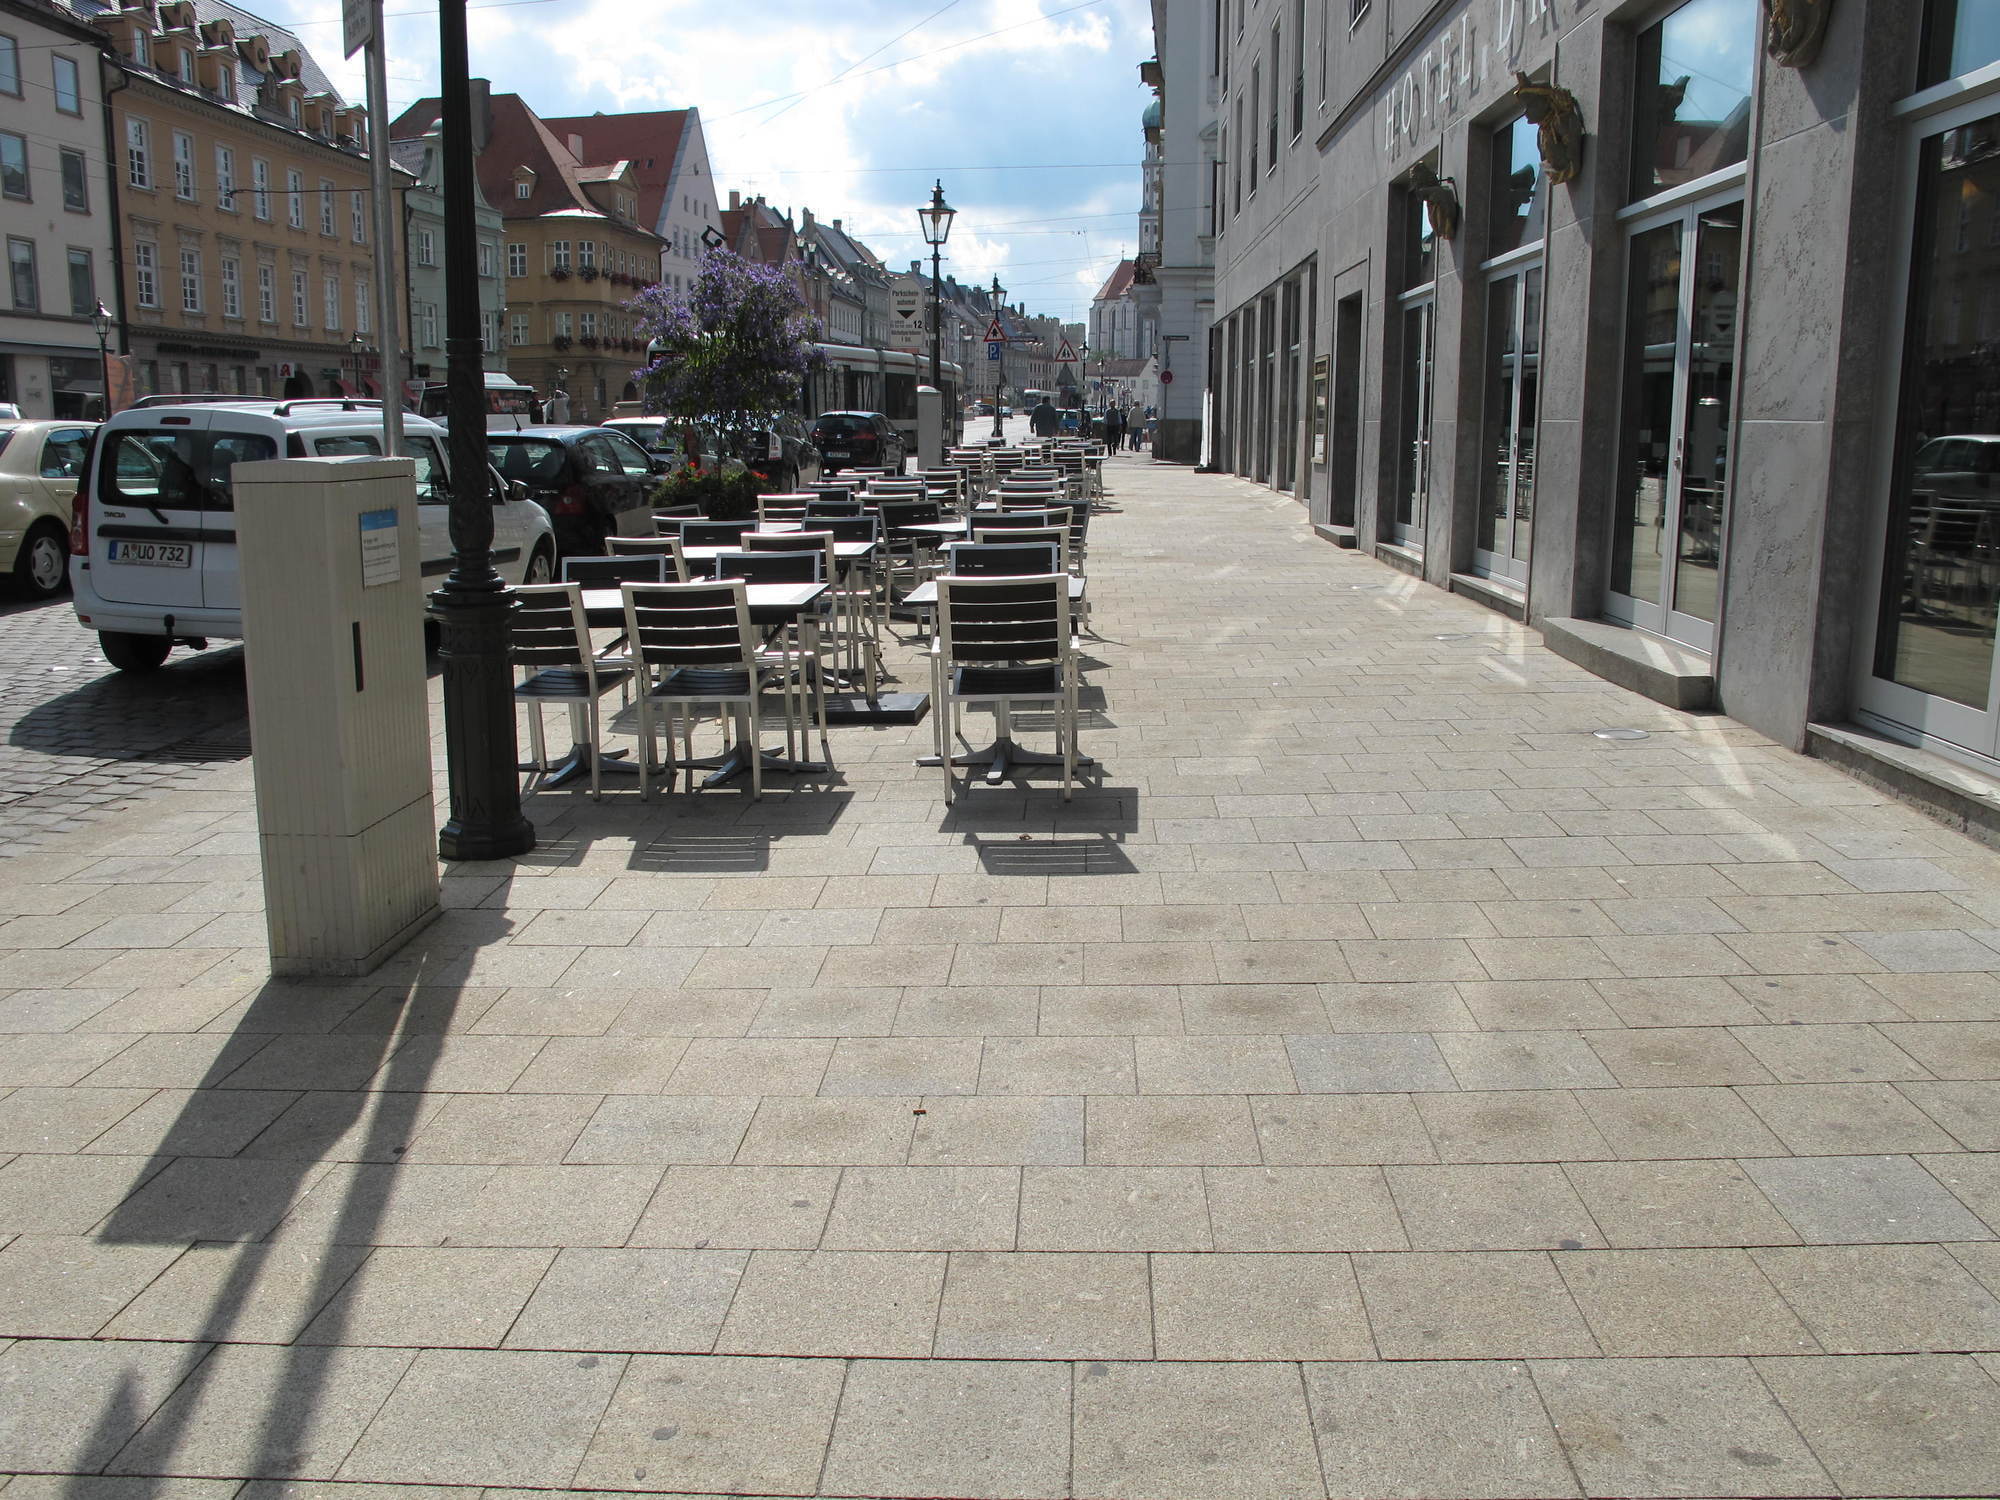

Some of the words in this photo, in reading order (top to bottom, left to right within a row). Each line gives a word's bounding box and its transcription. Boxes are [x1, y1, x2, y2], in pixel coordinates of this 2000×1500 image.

[1384, 13, 1472, 151] HOTEL
[913, 320, 923, 329] 12
[159, 546, 184, 562] 732
